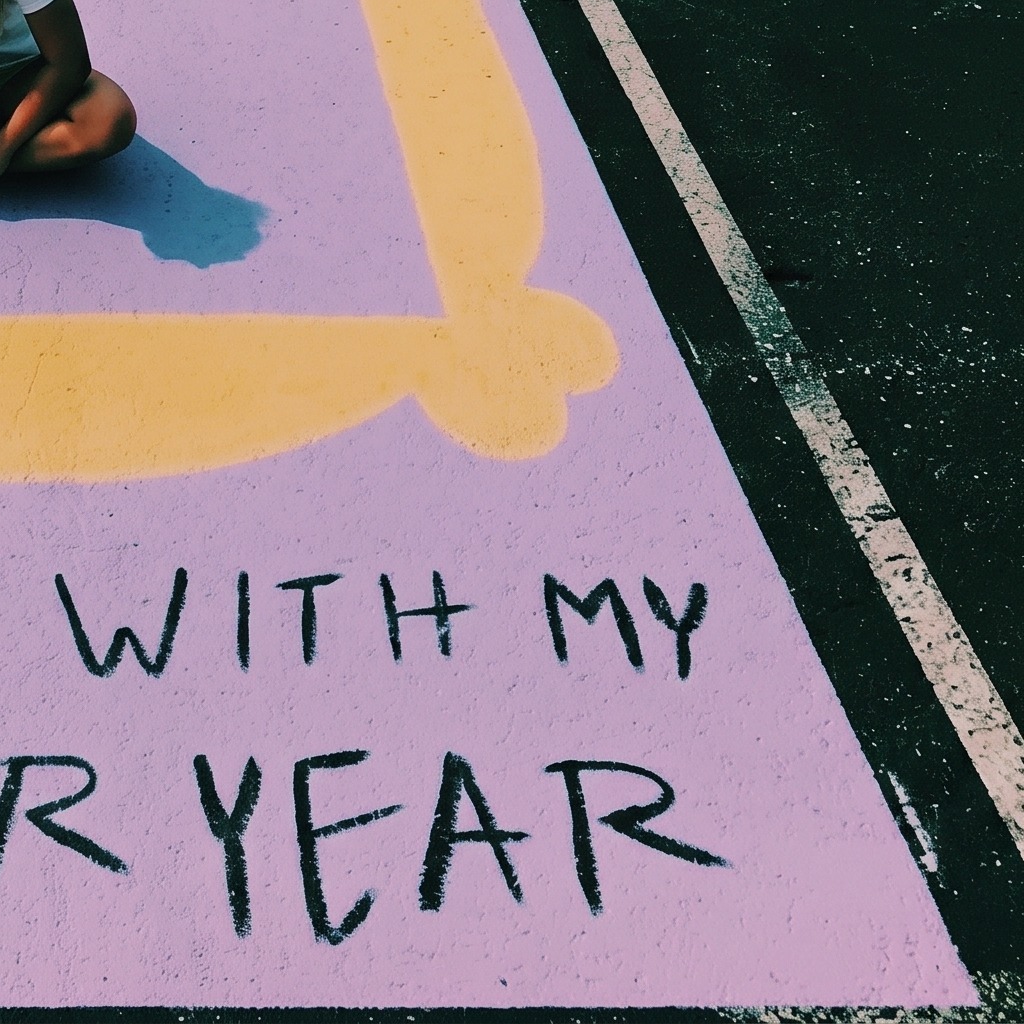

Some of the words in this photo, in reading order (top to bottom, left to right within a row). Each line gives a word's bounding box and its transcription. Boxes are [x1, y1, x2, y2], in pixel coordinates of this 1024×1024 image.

[54, 566, 476, 679] WITH
[543, 573, 709, 682] MY
[192, 748, 731, 947] YEAR
